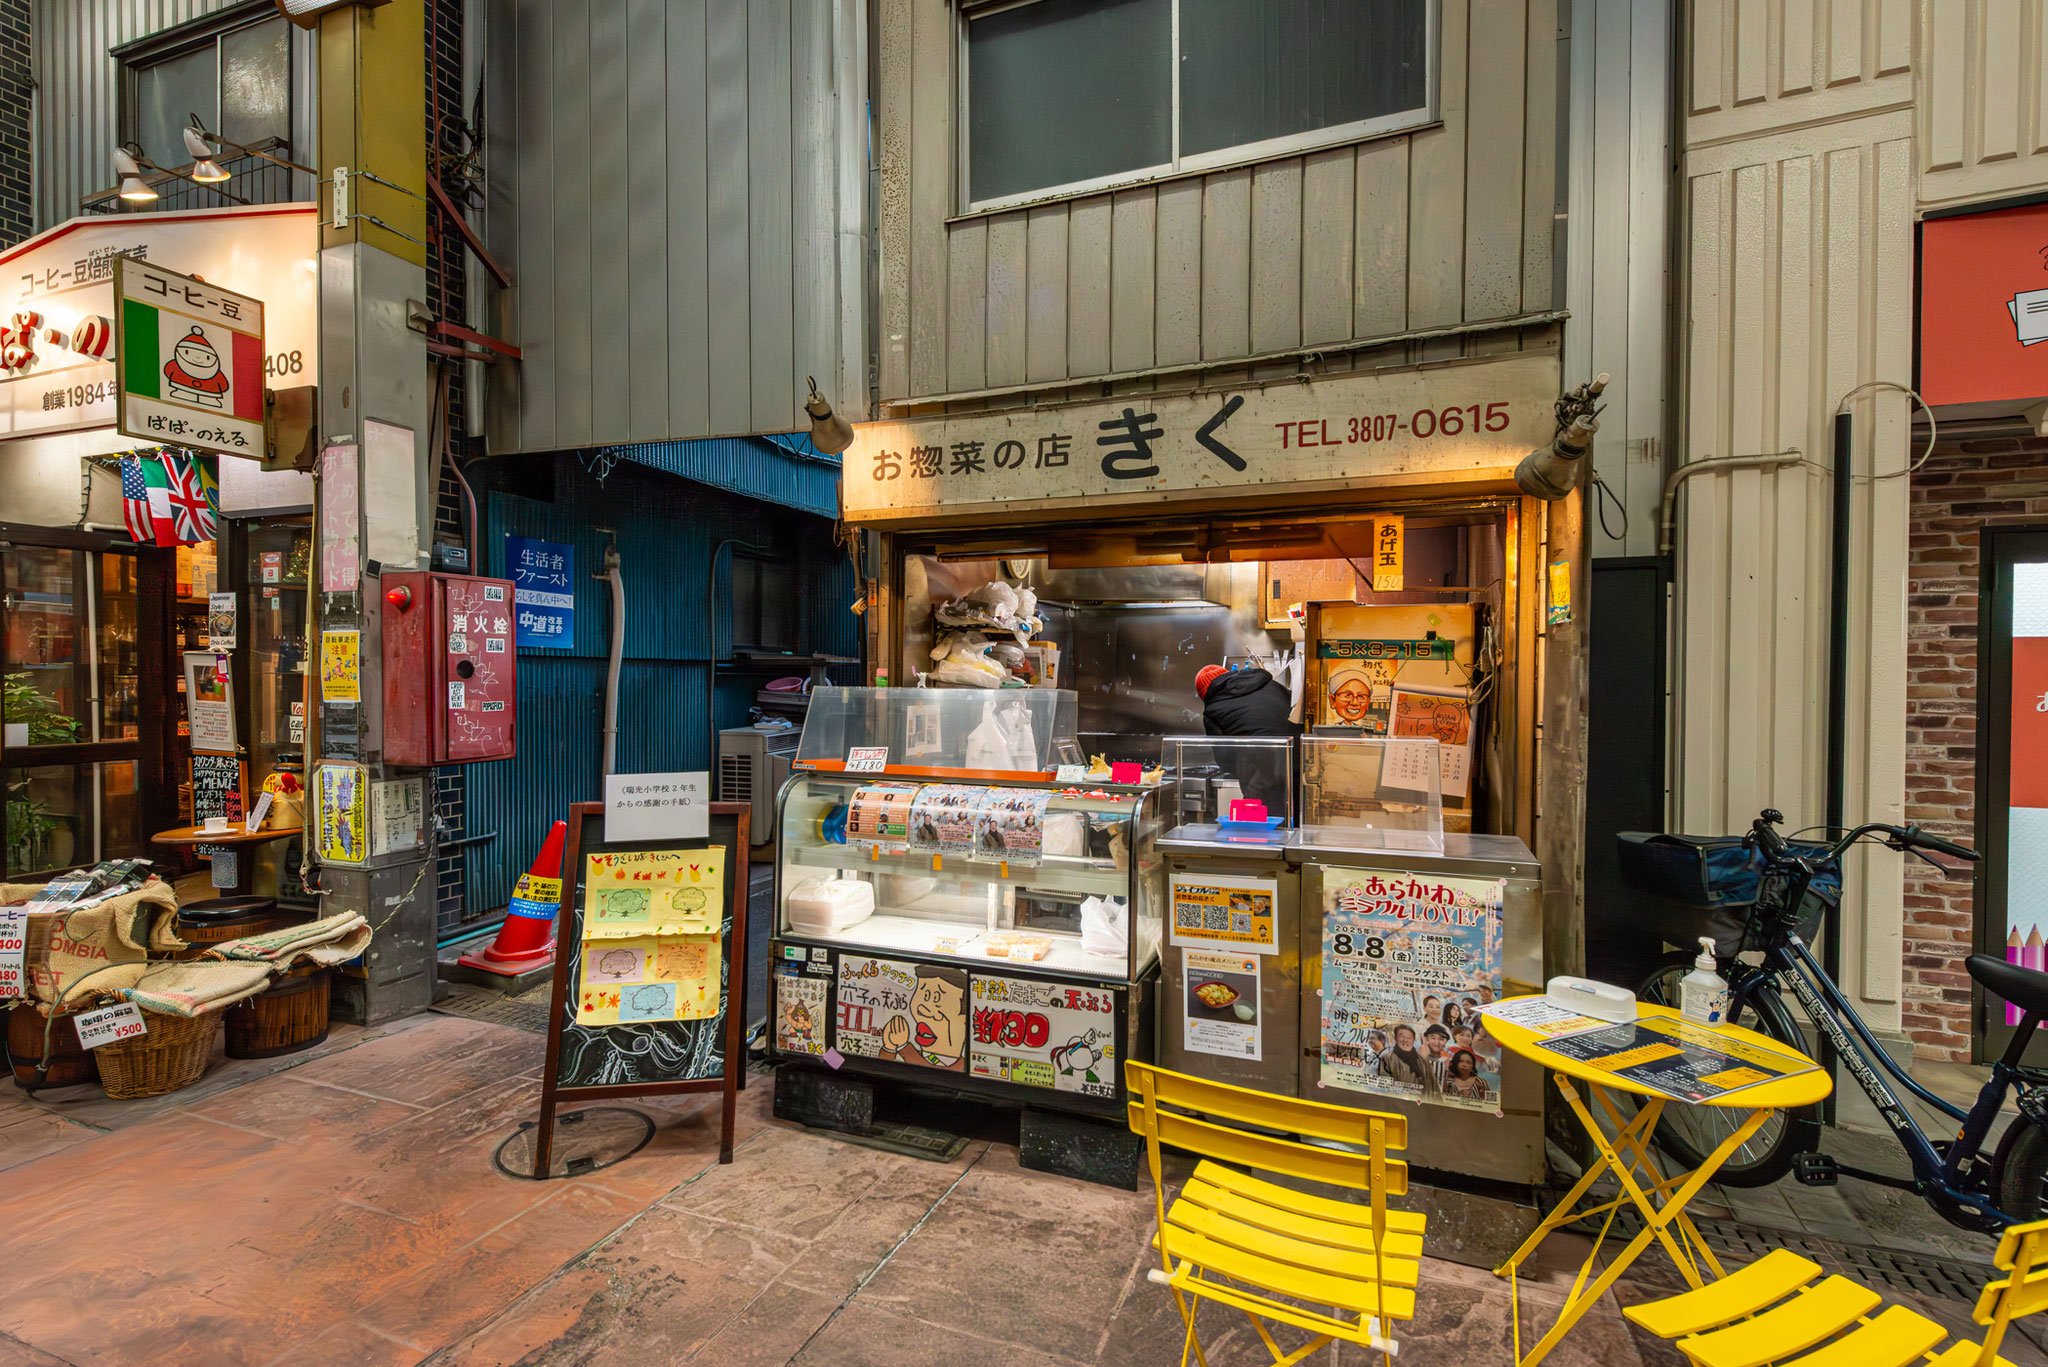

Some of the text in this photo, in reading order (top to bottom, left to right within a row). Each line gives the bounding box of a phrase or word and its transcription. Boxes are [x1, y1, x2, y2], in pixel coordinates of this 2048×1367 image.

[144, 273, 243, 321] コーヒー豆
[147, 415, 249, 447] ぱぱ・のえる
[1275, 402, 1510, 449] TEL 3807-0615
[872, 395, 1248, 482] お惣菜の店 きく
[325, 451, 339, 588] ポイントカード
[1379, 524, 1397, 566] あげ玉
[520, 549, 564, 571] 生活者
[515, 568, 568, 587] ファースト
[1376, 575, 1400, 589] 150
[453, 615, 508, 635] 消火栓
[519, 610, 547, 632] 中道
[325, 635, 357, 644] 自転車走行
[331, 645, 348, 656] 注意
[1361, 659, 1383, 669] 初代
[1365, 875, 1455, 906] あらかわ
[1340, 896, 1480, 927] ミラクルLOVE!
[1334, 924, 1372, 936] 2025年
[1419, 934, 1452, 944] 上映時間
[1333, 933, 1412, 963] 8.8 (金)
[881, 964, 916, 988] サクサク
[1333, 961, 1378, 972] ムーブ町屋
[1396, 966, 1450, 979] トークゲスト
[840, 983, 908, 1011] 穴子の天ぷら
[972, 979, 1112, 1014] 半熟たまごの天ぷら
[114, 1022, 142, 1038] ¥500
[807, 1040, 824, 1055] きく
[841, 1034, 862, 1053] 穴子
